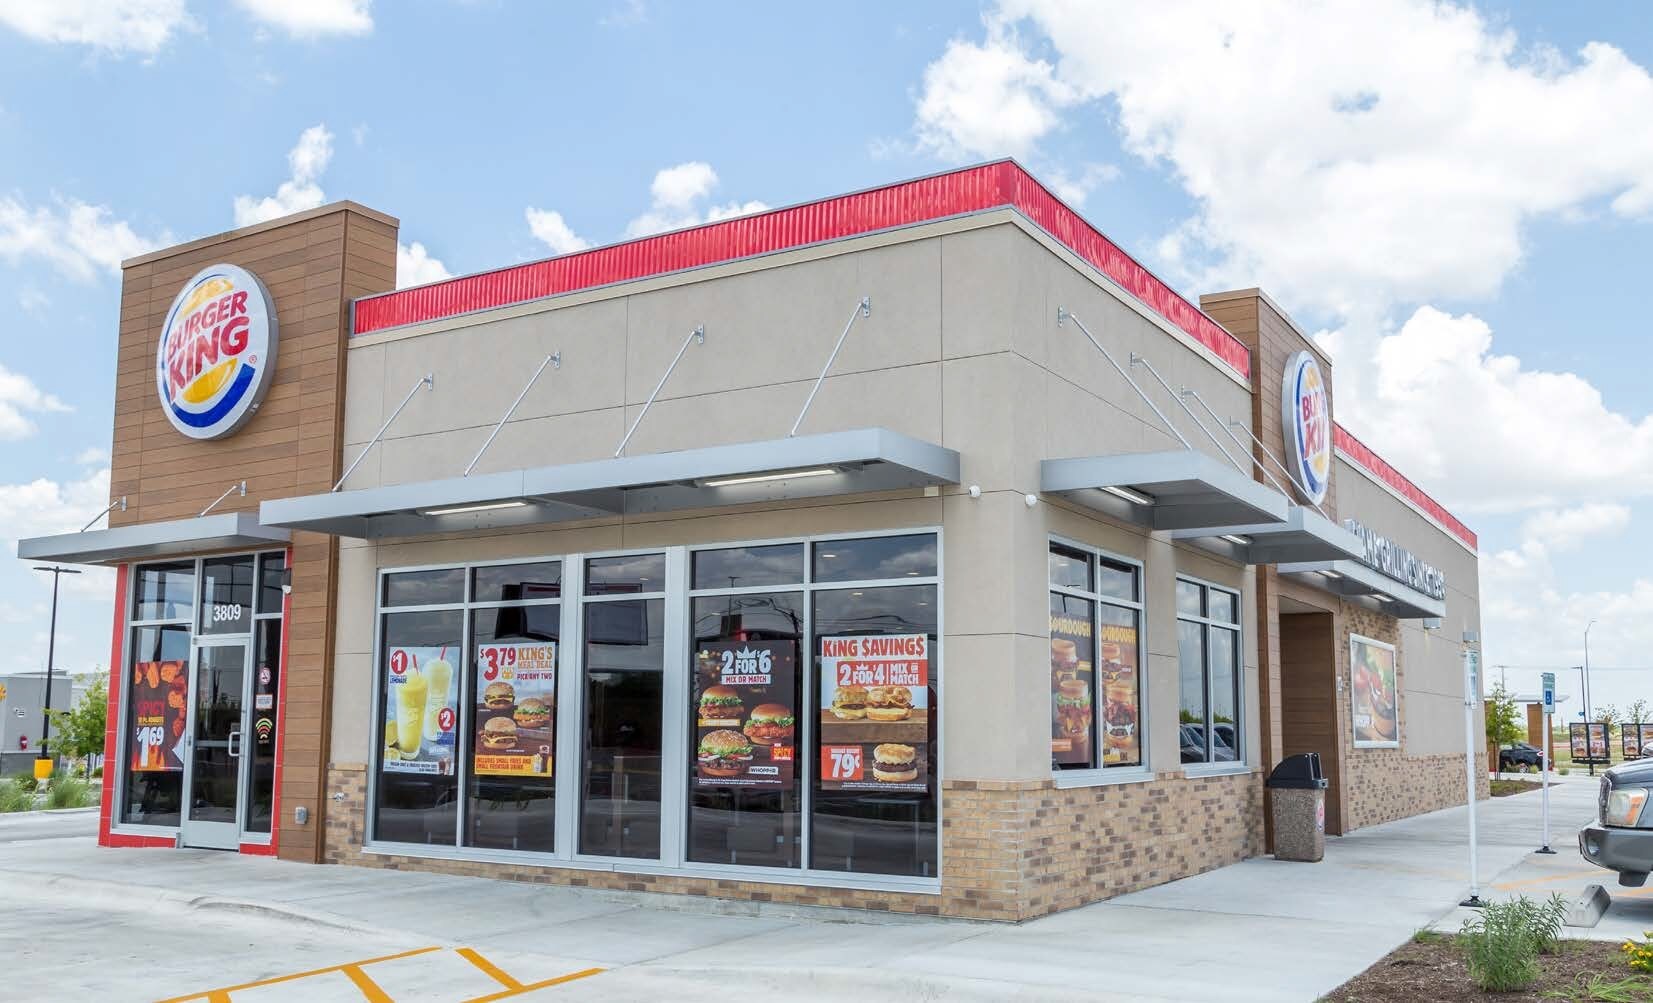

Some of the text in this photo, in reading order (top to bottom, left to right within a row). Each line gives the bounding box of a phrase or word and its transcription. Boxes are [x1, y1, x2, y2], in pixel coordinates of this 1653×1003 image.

[168, 291, 248, 362] BURGER
[169, 316, 249, 402] KING
[213, 604, 241, 621] 3809
[393, 652, 403, 671] $1
[518, 647, 552, 660] KING'S
[722, 650, 733, 674] 2
[735, 659, 757, 674] FOR
[726, 675, 767, 683] MIX OR MATCH
[840, 664, 852, 686] 2
[853, 671, 873, 685] FOR
[873, 663, 885, 685] $4
[890, 663, 907, 673] MIX
[890, 674, 918, 685] MATCH
[440, 711, 452, 727] $2
